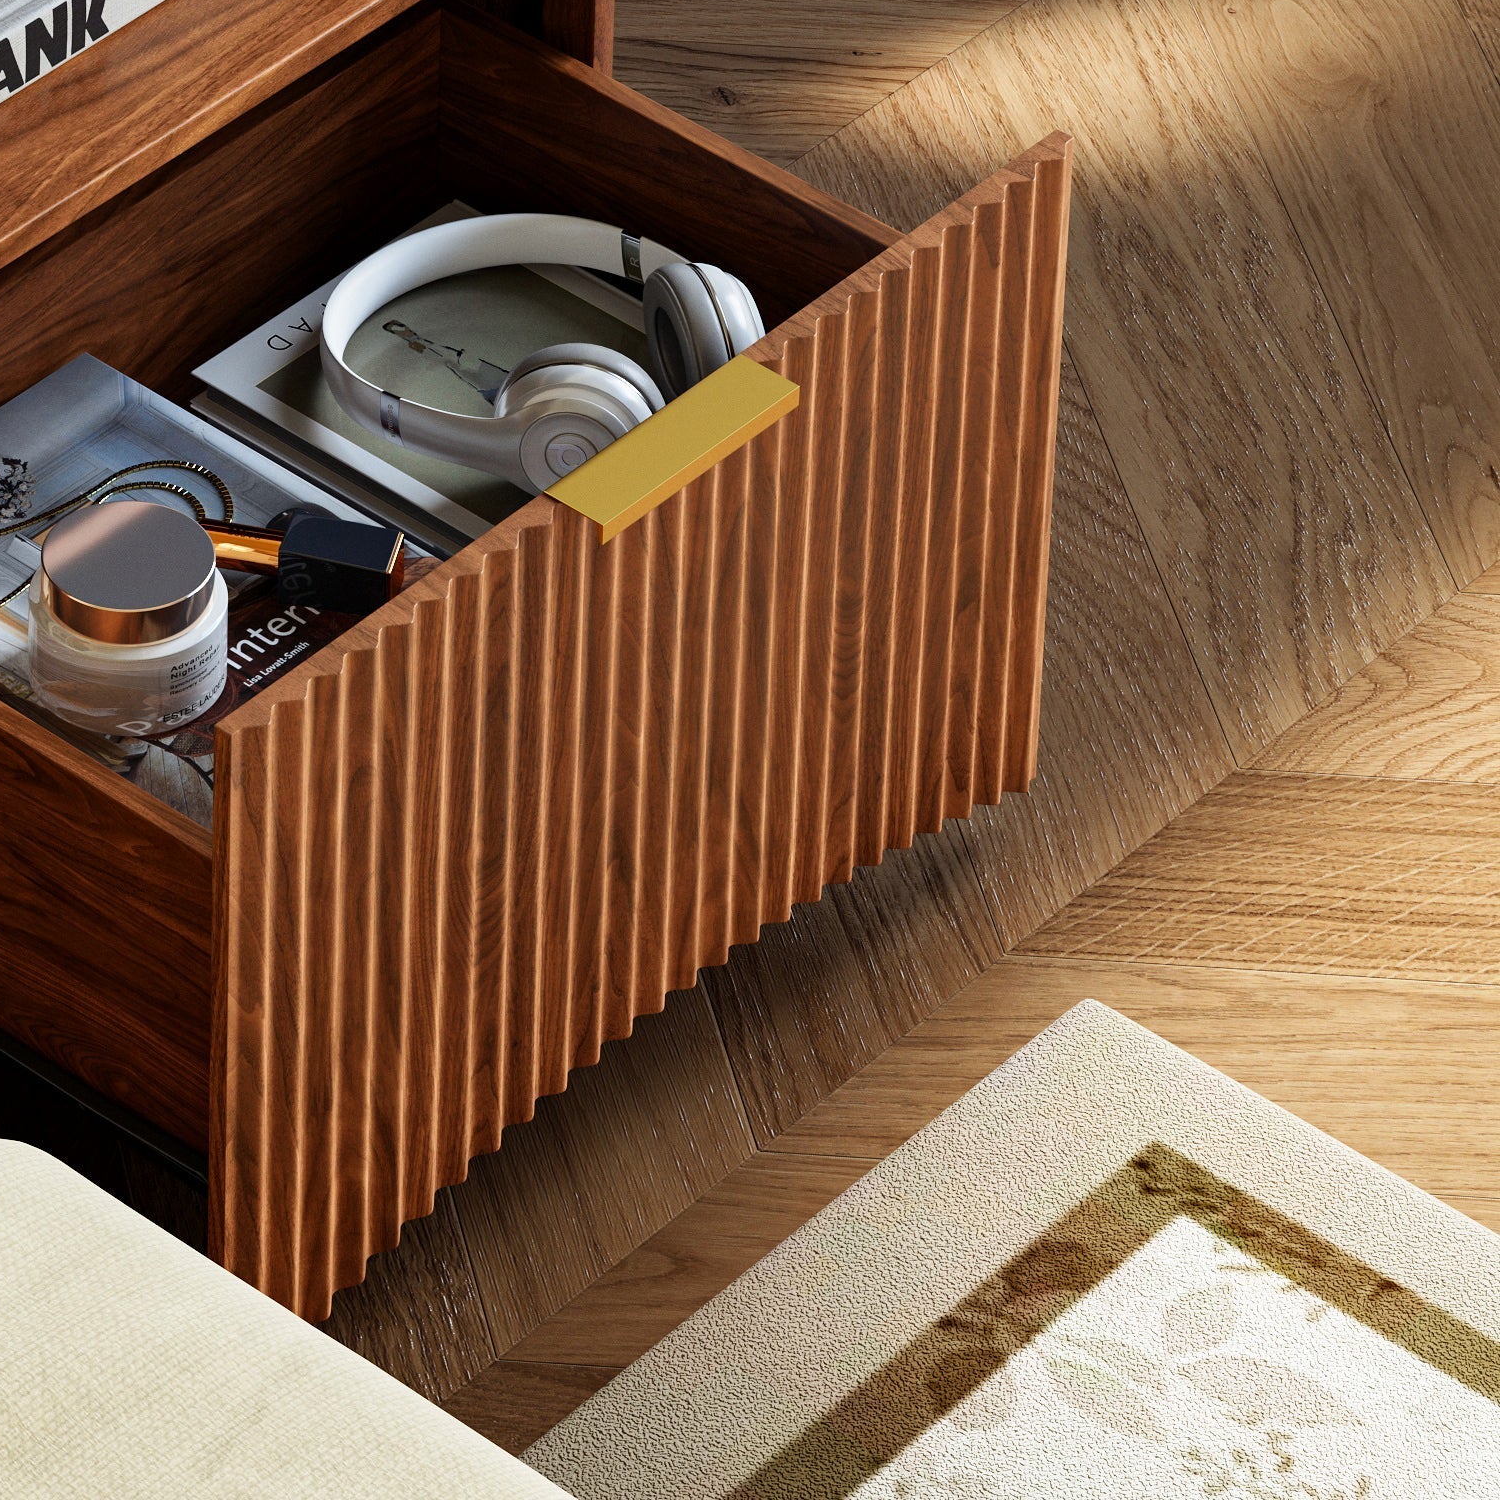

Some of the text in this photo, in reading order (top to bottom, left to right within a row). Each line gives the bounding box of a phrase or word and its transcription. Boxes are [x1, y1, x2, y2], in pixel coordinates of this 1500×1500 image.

[170, 645, 213, 672] Advanced
[243, 641, 310, 687] Lisa Lovatt-Smith
[170, 666, 197, 680] Night
